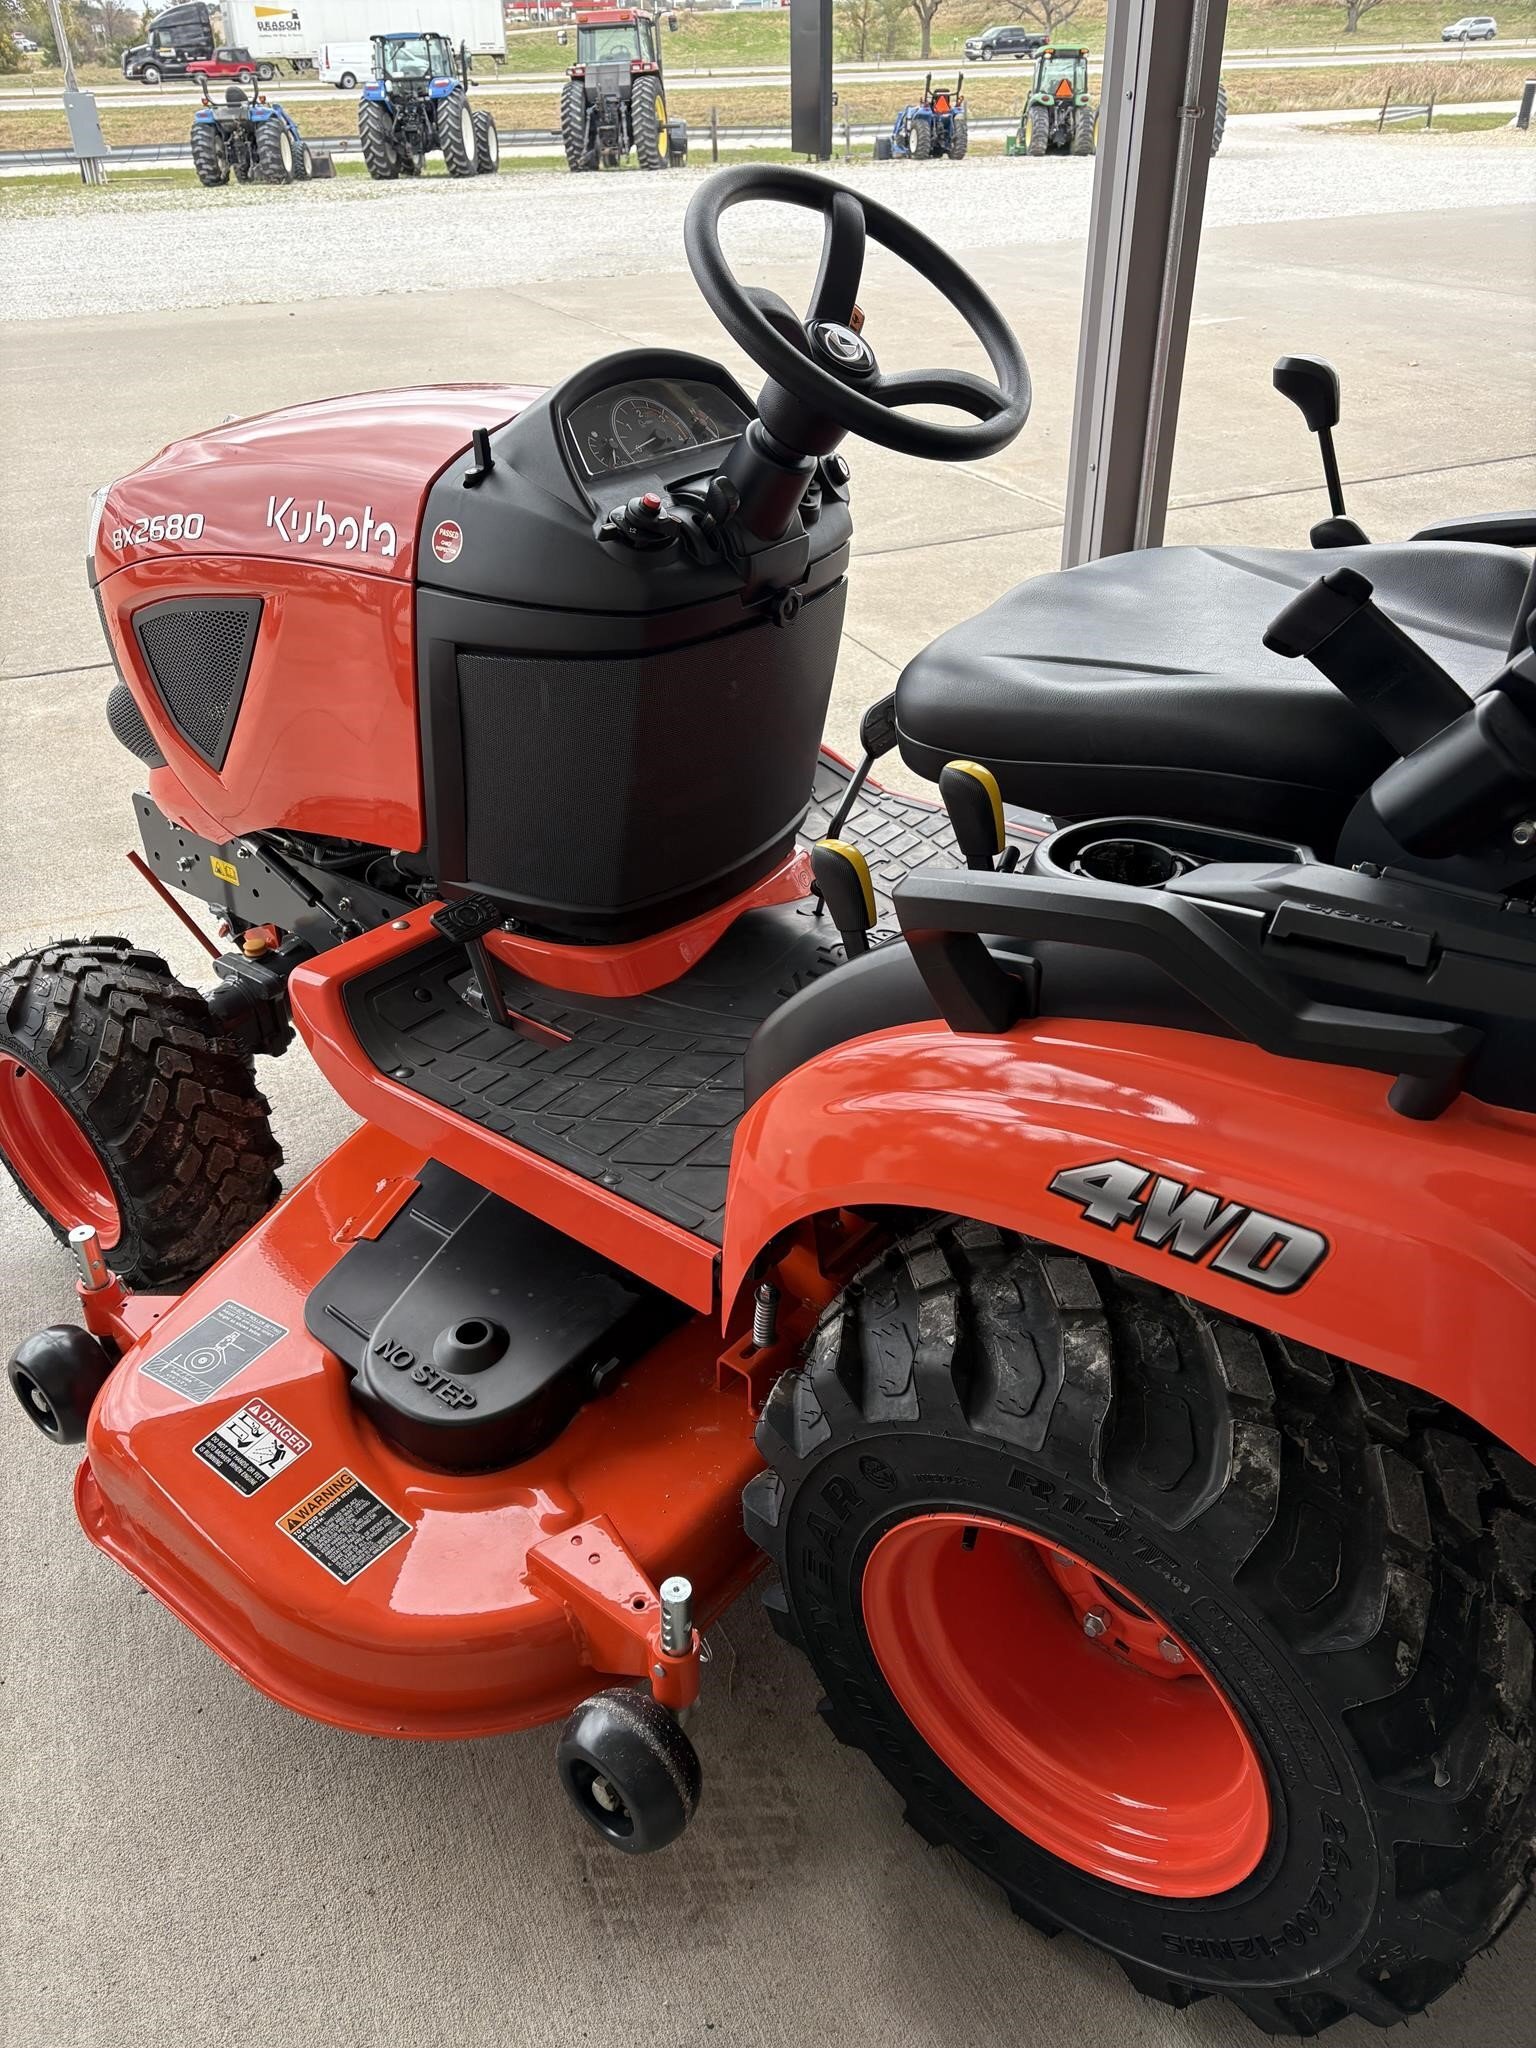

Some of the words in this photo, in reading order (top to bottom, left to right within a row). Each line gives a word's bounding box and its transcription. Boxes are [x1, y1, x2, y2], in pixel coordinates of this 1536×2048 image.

[257, 21, 301, 29] BEACON
[112, 513, 204, 550] BX2680
[267, 496, 398, 557] Kubota
[439, 528, 459, 539] PASSED
[1047, 1159, 1330, 1295] 4WD
[375, 1338, 415, 1371] NO
[411, 1364, 477, 1410] STEP
[259, 1410, 306, 1452] DANGER
[204, 1440, 217, 1451] INTO
[213, 1448, 232, 1464] MOWER
[228, 1461, 243, 1473] WHEN
[240, 1471, 257, 1486] ENGINE
[210, 1435, 220, 1443] DO
[216, 1440, 228, 1450] NOT
[224, 1447, 236, 1457] PUT
[232, 1454, 249, 1468] HANDS
[245, 1465, 255, 1474] OR
[252, 1471, 265, 1481] FEET
[293, 1528, 303, 1536] TO
[300, 1515, 319, 1530] AVOID
[317, 1496, 341, 1517] SERIOUS
[339, 1482, 359, 1498] INJURY
[295, 1474, 353, 1520] WARNING
[296, 1531, 307, 1540] OR
